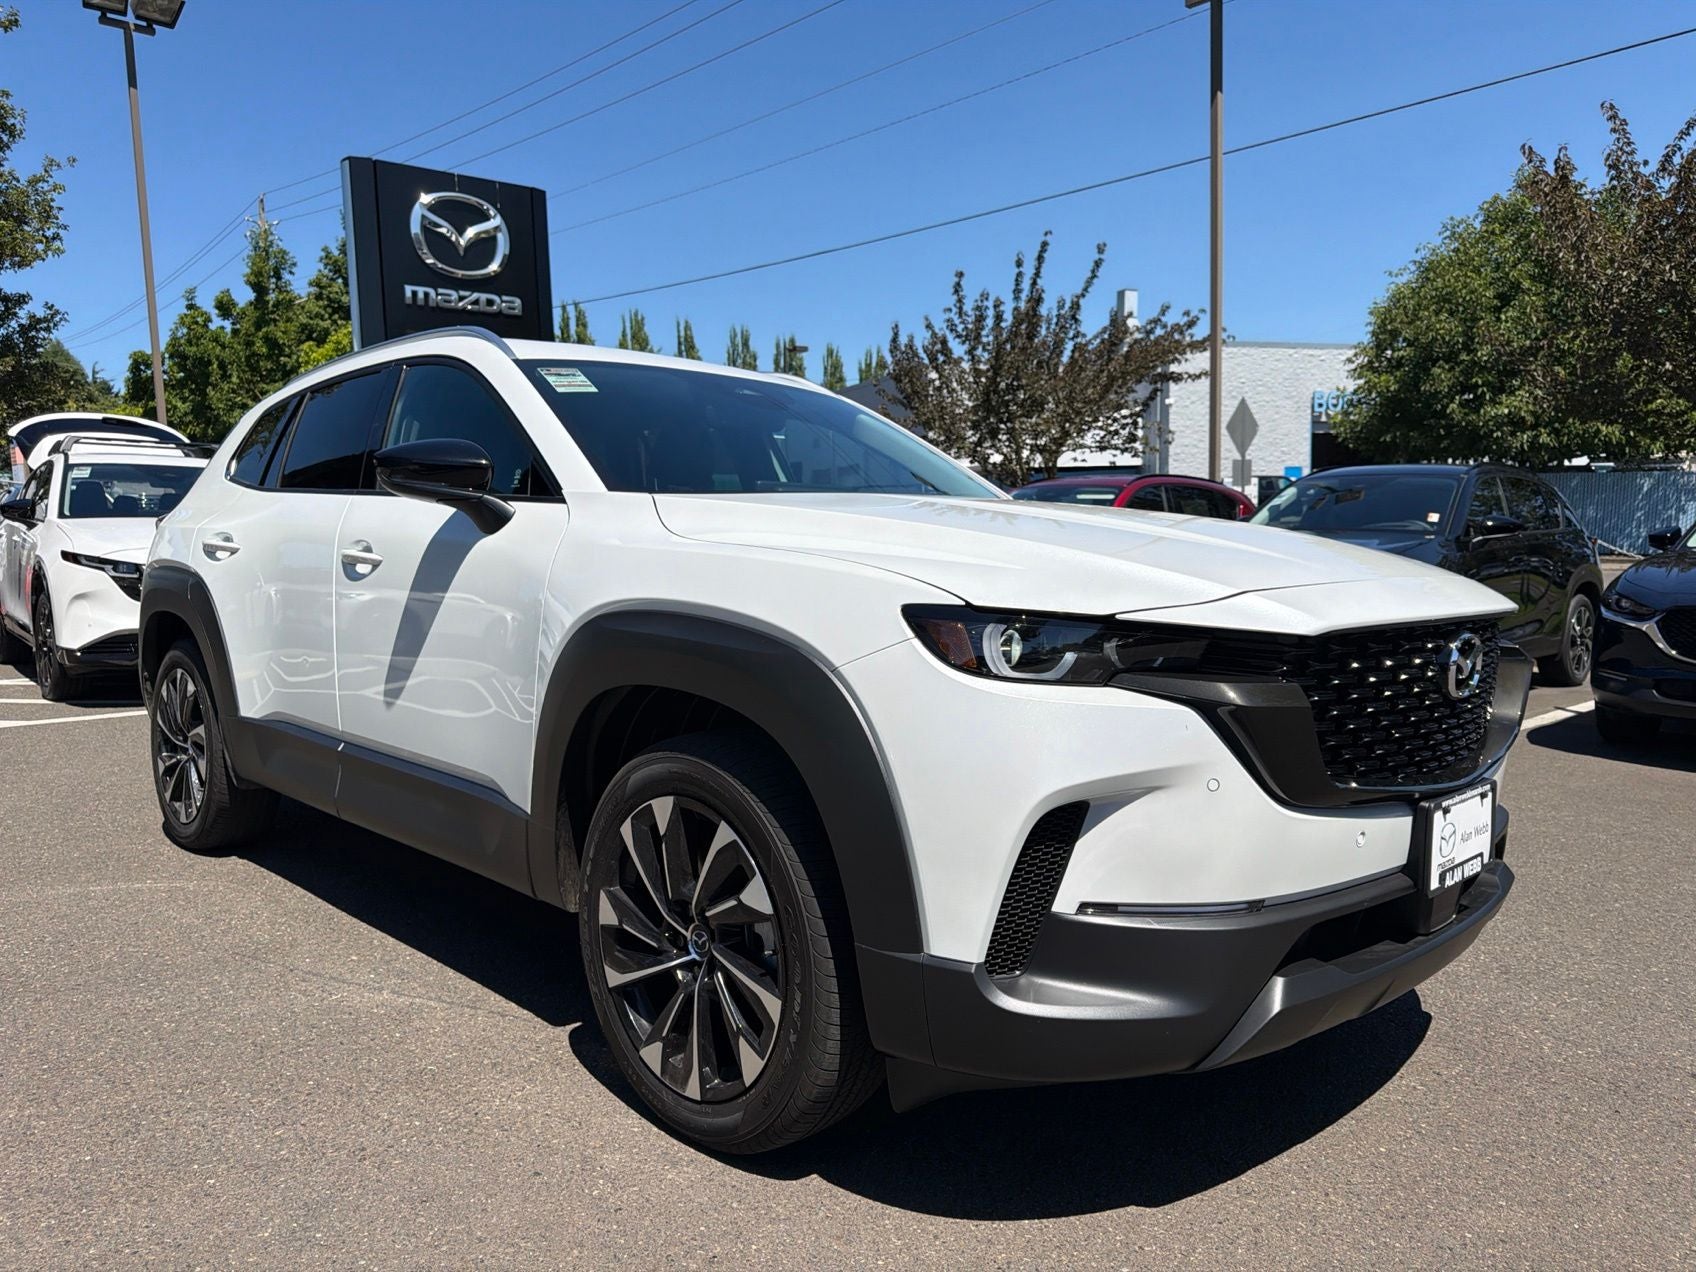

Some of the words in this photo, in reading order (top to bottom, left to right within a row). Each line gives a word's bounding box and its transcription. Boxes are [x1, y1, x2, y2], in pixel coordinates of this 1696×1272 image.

[1460, 830, 1473, 845] Alan
[1473, 821, 1489, 838] Webb
[1444, 865, 1463, 889] ALAN
[1463, 856, 1482, 878] WEBB
